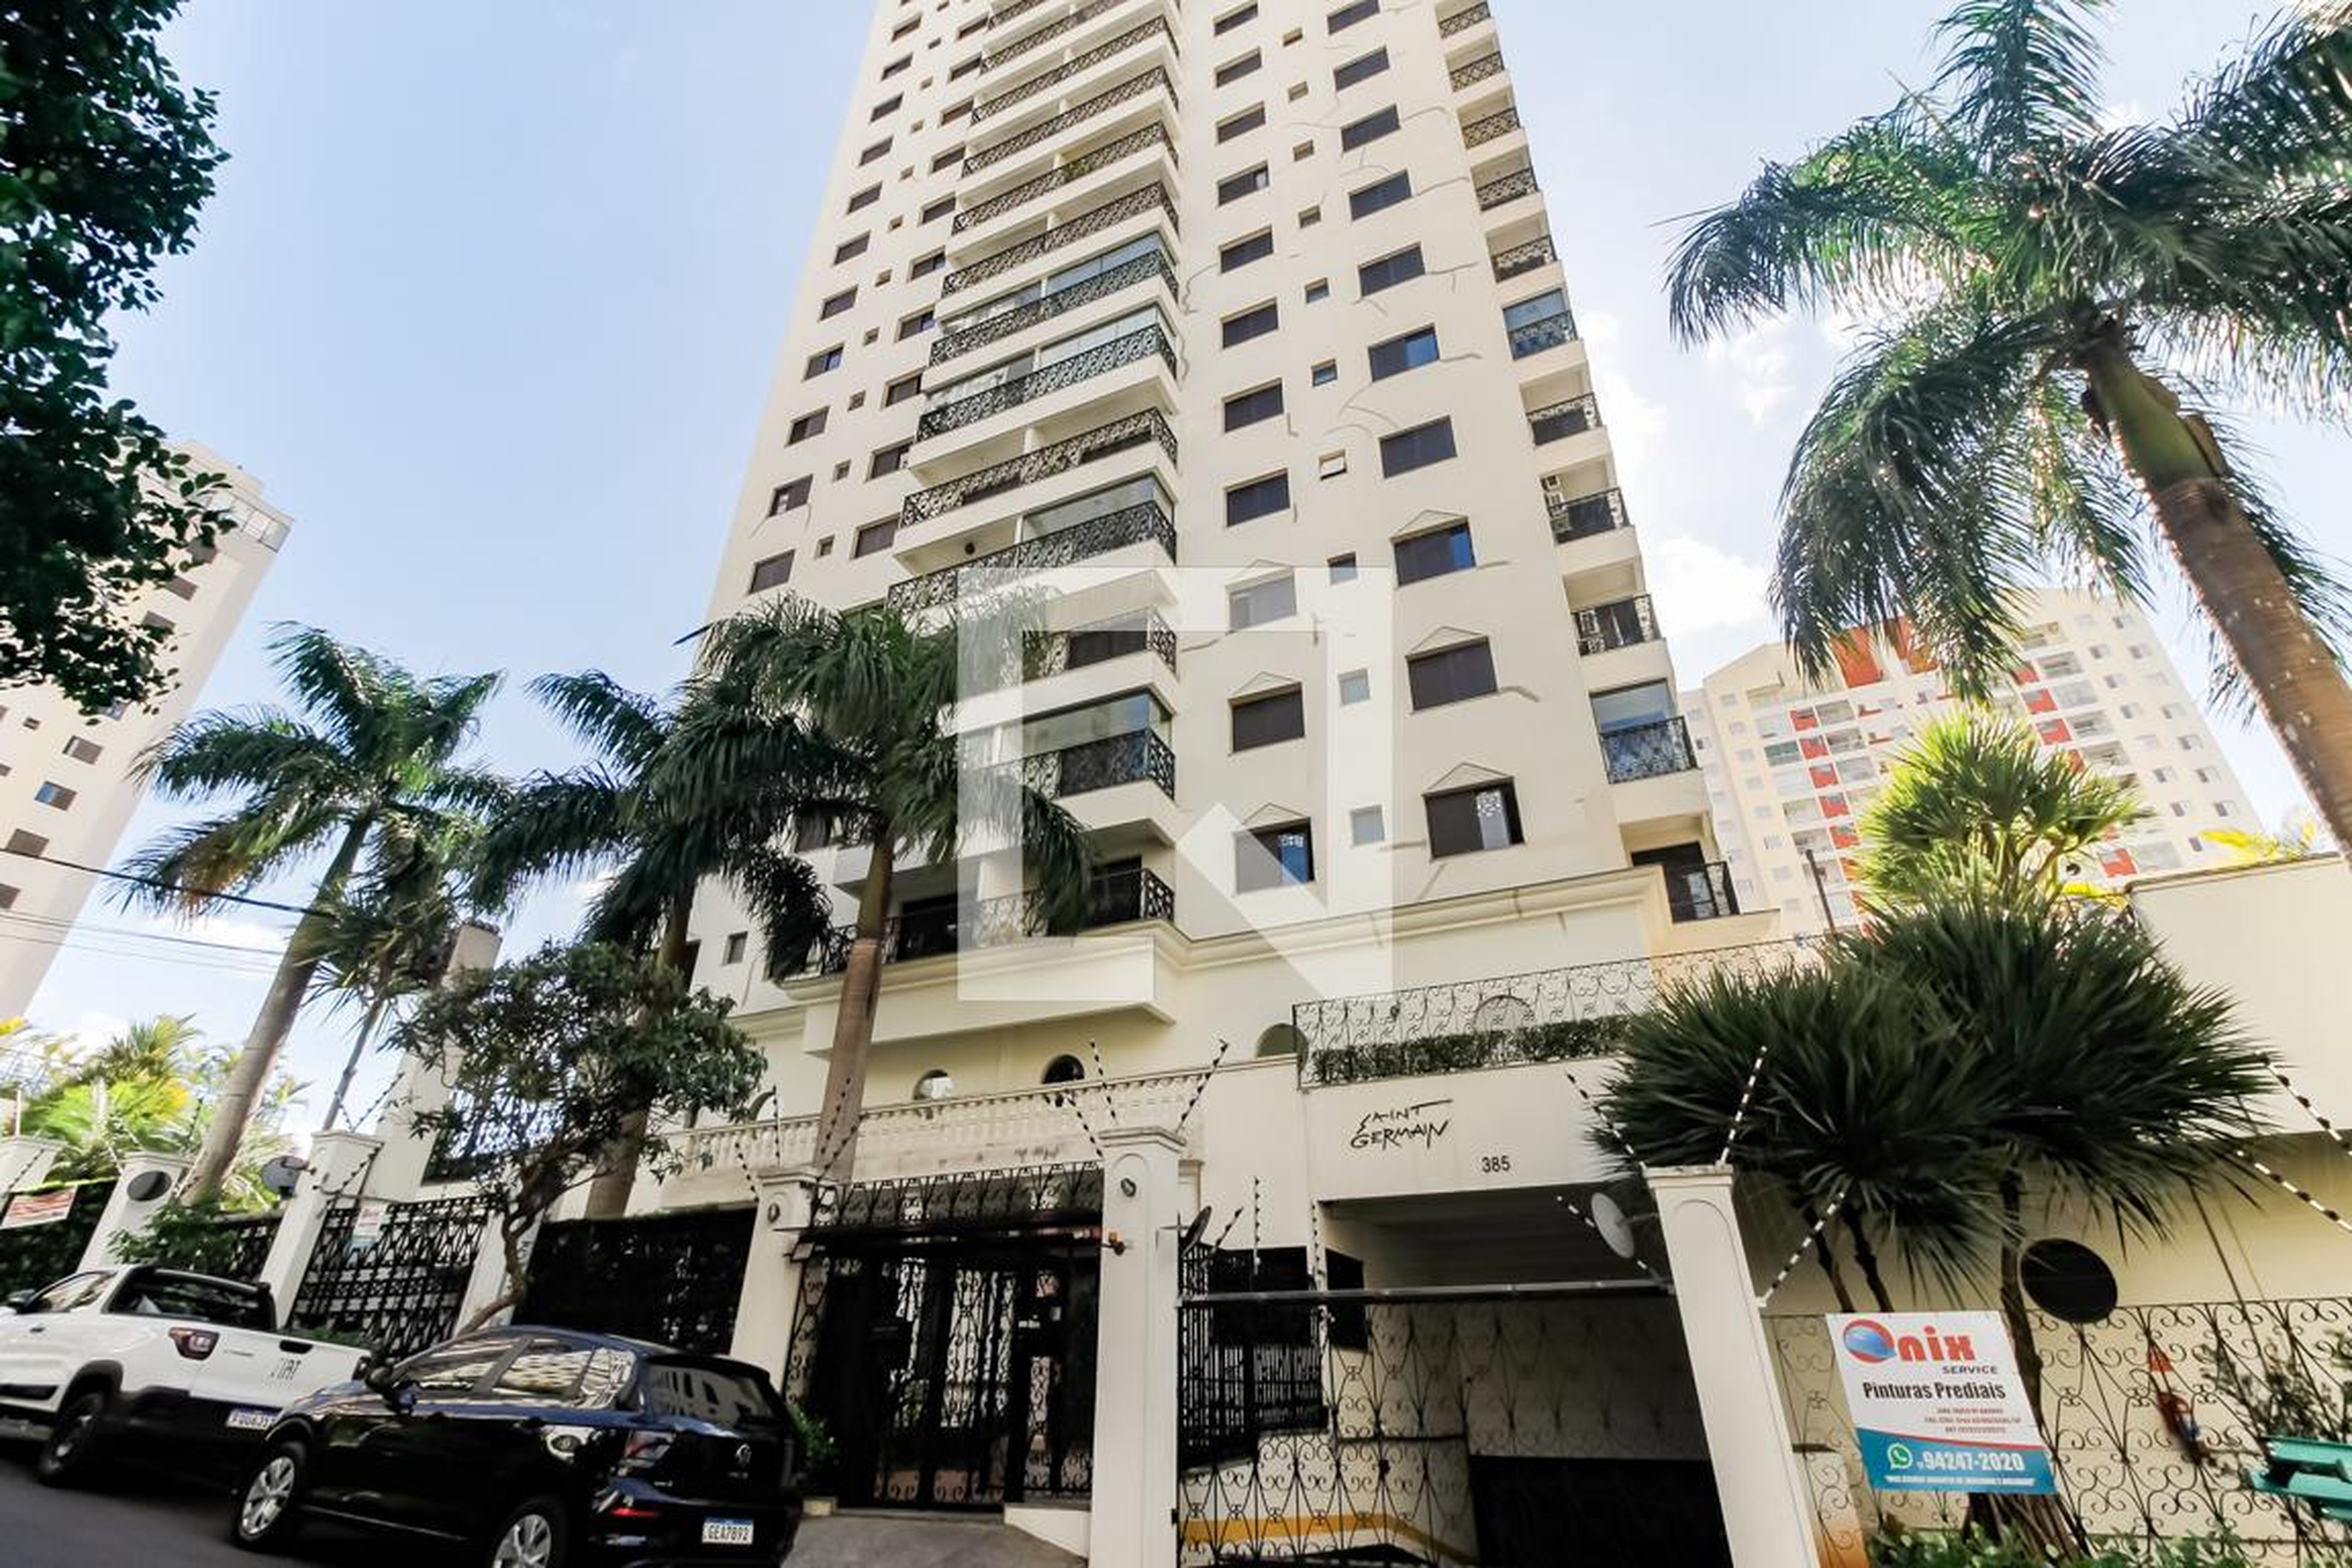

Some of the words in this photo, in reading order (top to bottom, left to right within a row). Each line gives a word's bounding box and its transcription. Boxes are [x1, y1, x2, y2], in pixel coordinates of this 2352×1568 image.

[1357, 1099, 1453, 1133] SAINT
[1350, 1119, 1450, 1150] GERMAIN
[1481, 1155, 1511, 1173] 385
[1942, 1365, 1998, 1374] SERVICE
[1862, 1382, 1932, 1400] Pinturas
[1935, 1382, 2007, 1400] Prediais
[1922, 1450, 2026, 1471] 94247-2020
